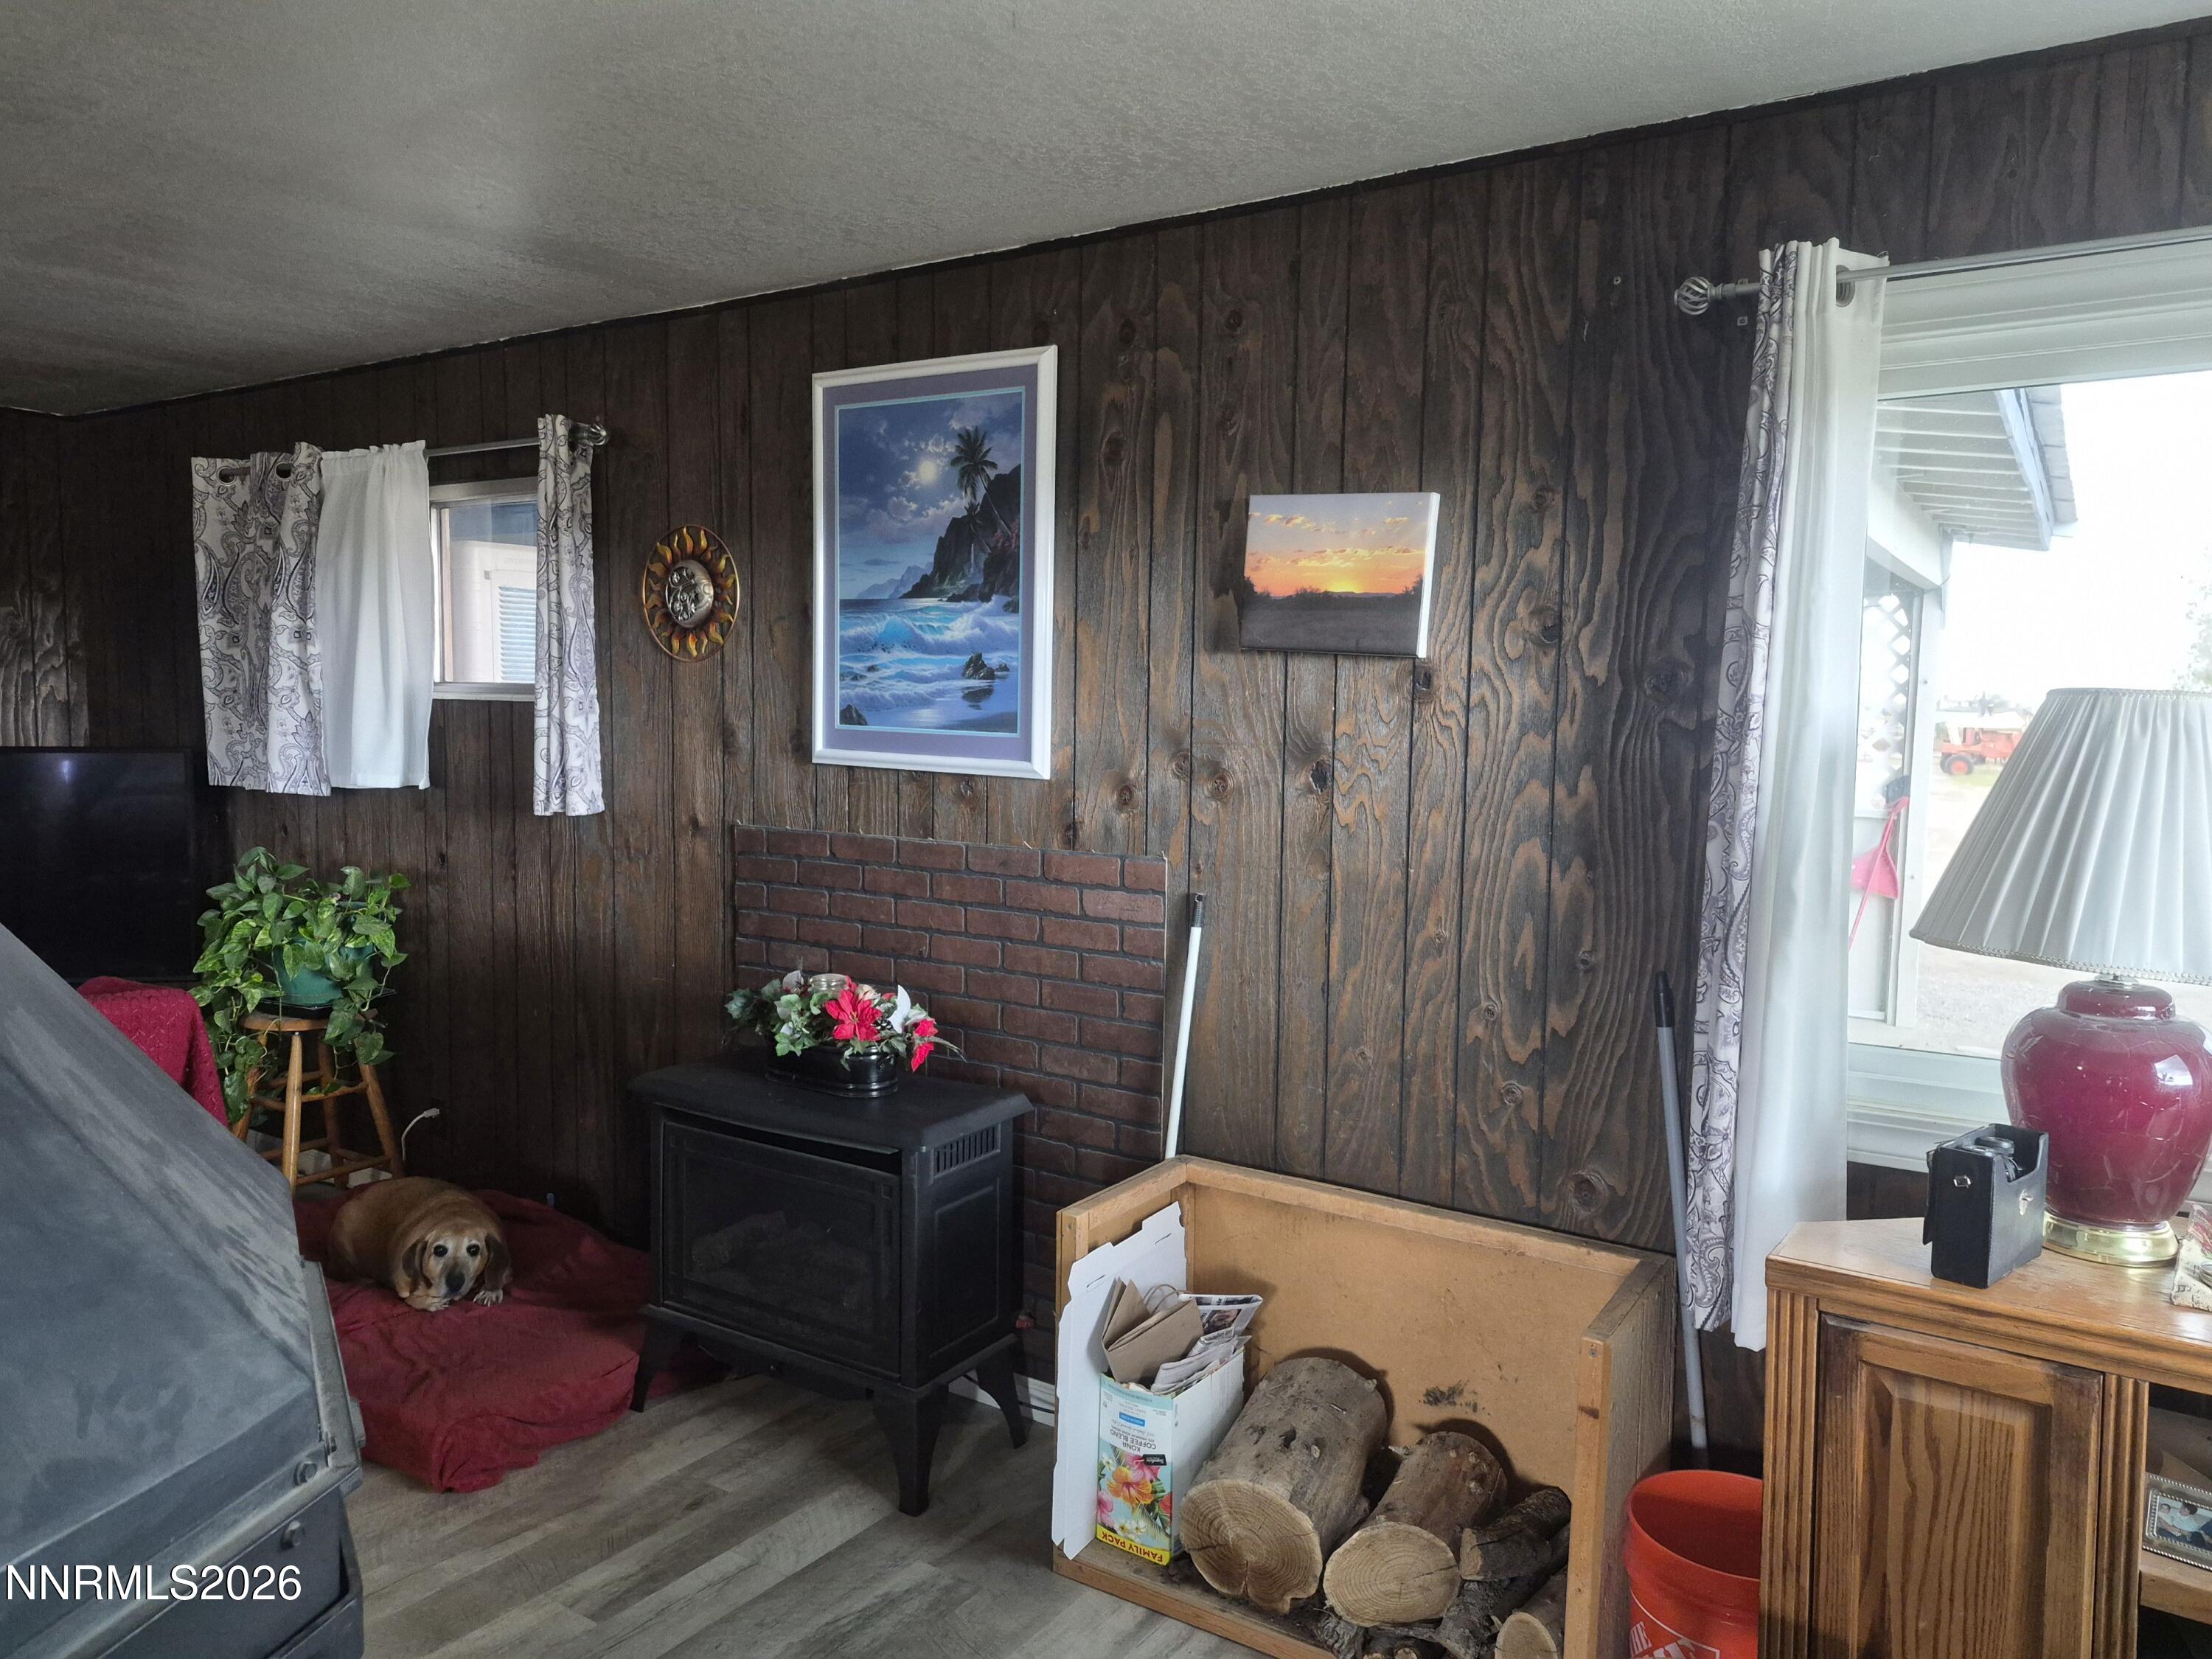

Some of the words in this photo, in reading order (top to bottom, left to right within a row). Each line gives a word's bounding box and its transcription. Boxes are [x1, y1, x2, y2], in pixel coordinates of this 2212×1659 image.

[1110, 1429, 1129, 1442] BLEND
[1122, 1441, 1141, 1453] KONA
[1130, 1437, 1157, 1450] COFFEE
[1102, 1531, 1126, 1548] PACK
[1128, 1543, 1163, 1562] FAMILY
